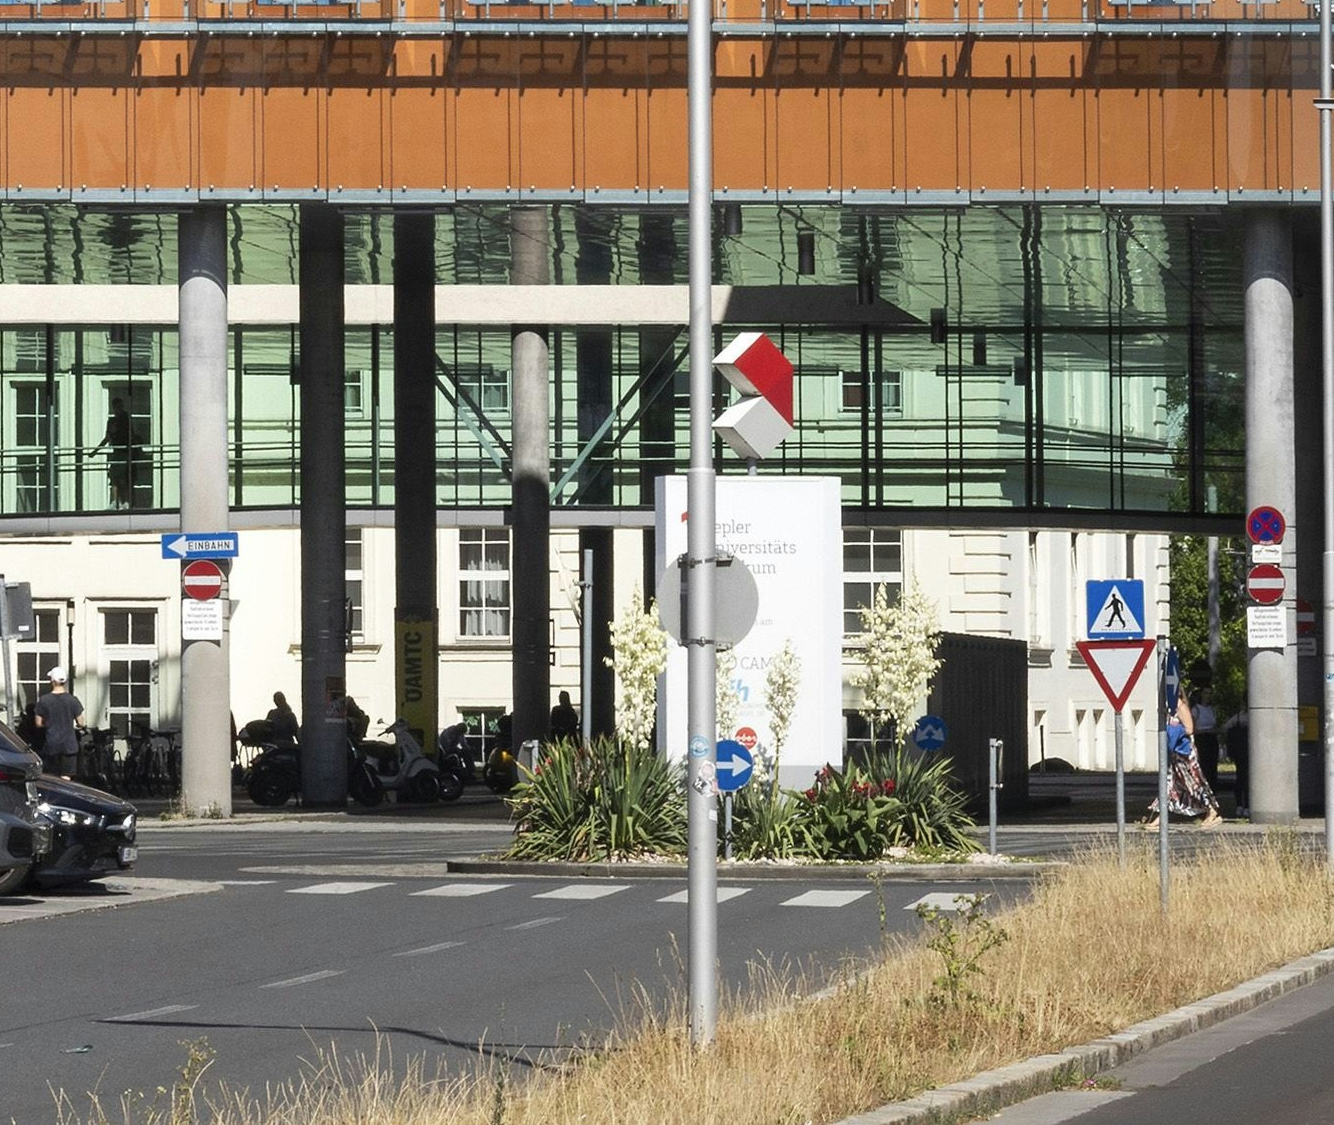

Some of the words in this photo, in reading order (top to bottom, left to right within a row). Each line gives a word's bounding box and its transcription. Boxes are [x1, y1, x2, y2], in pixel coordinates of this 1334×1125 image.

[715, 519, 752, 537] epler
[187, 540, 232, 551] EINBAHN
[716, 539, 797, 556] niversitäts
